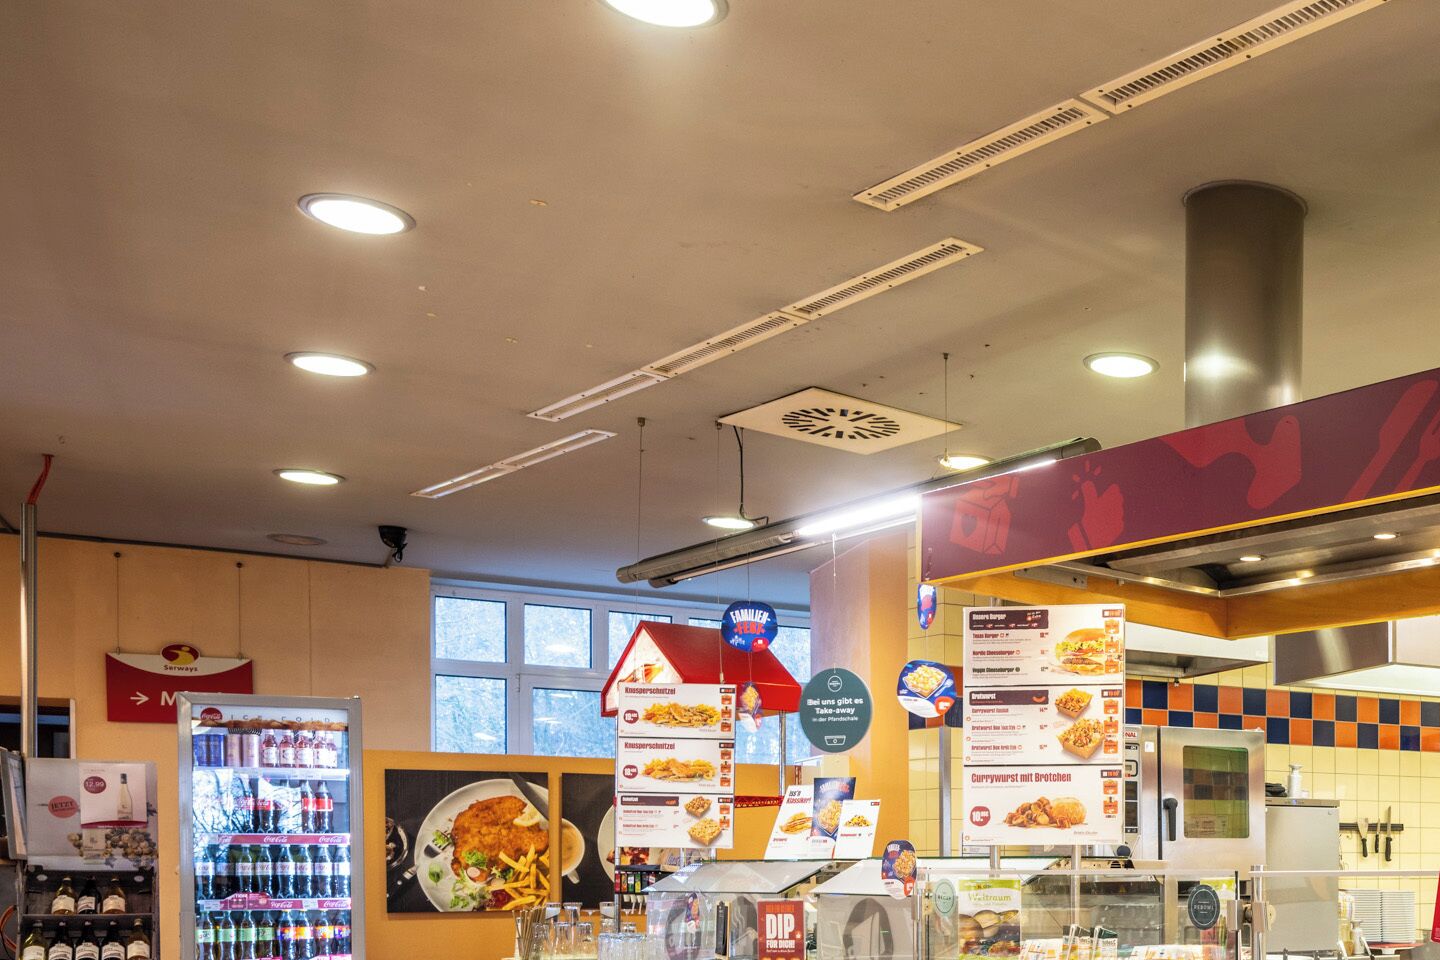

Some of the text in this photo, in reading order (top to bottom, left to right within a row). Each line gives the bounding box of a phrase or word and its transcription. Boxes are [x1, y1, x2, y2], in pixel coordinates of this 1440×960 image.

[164, 665, 198, 673] Serways
[625, 687, 676, 695] Knusperschnitzel
[837, 698, 852, 706] gibt
[815, 707, 855, 715] Take-away
[625, 742, 675, 750] Knusperschnitzel
[972, 773, 1019, 784] Currywurst
[1020, 773, 1033, 783] mit
[766, 914, 795, 939] DIP
